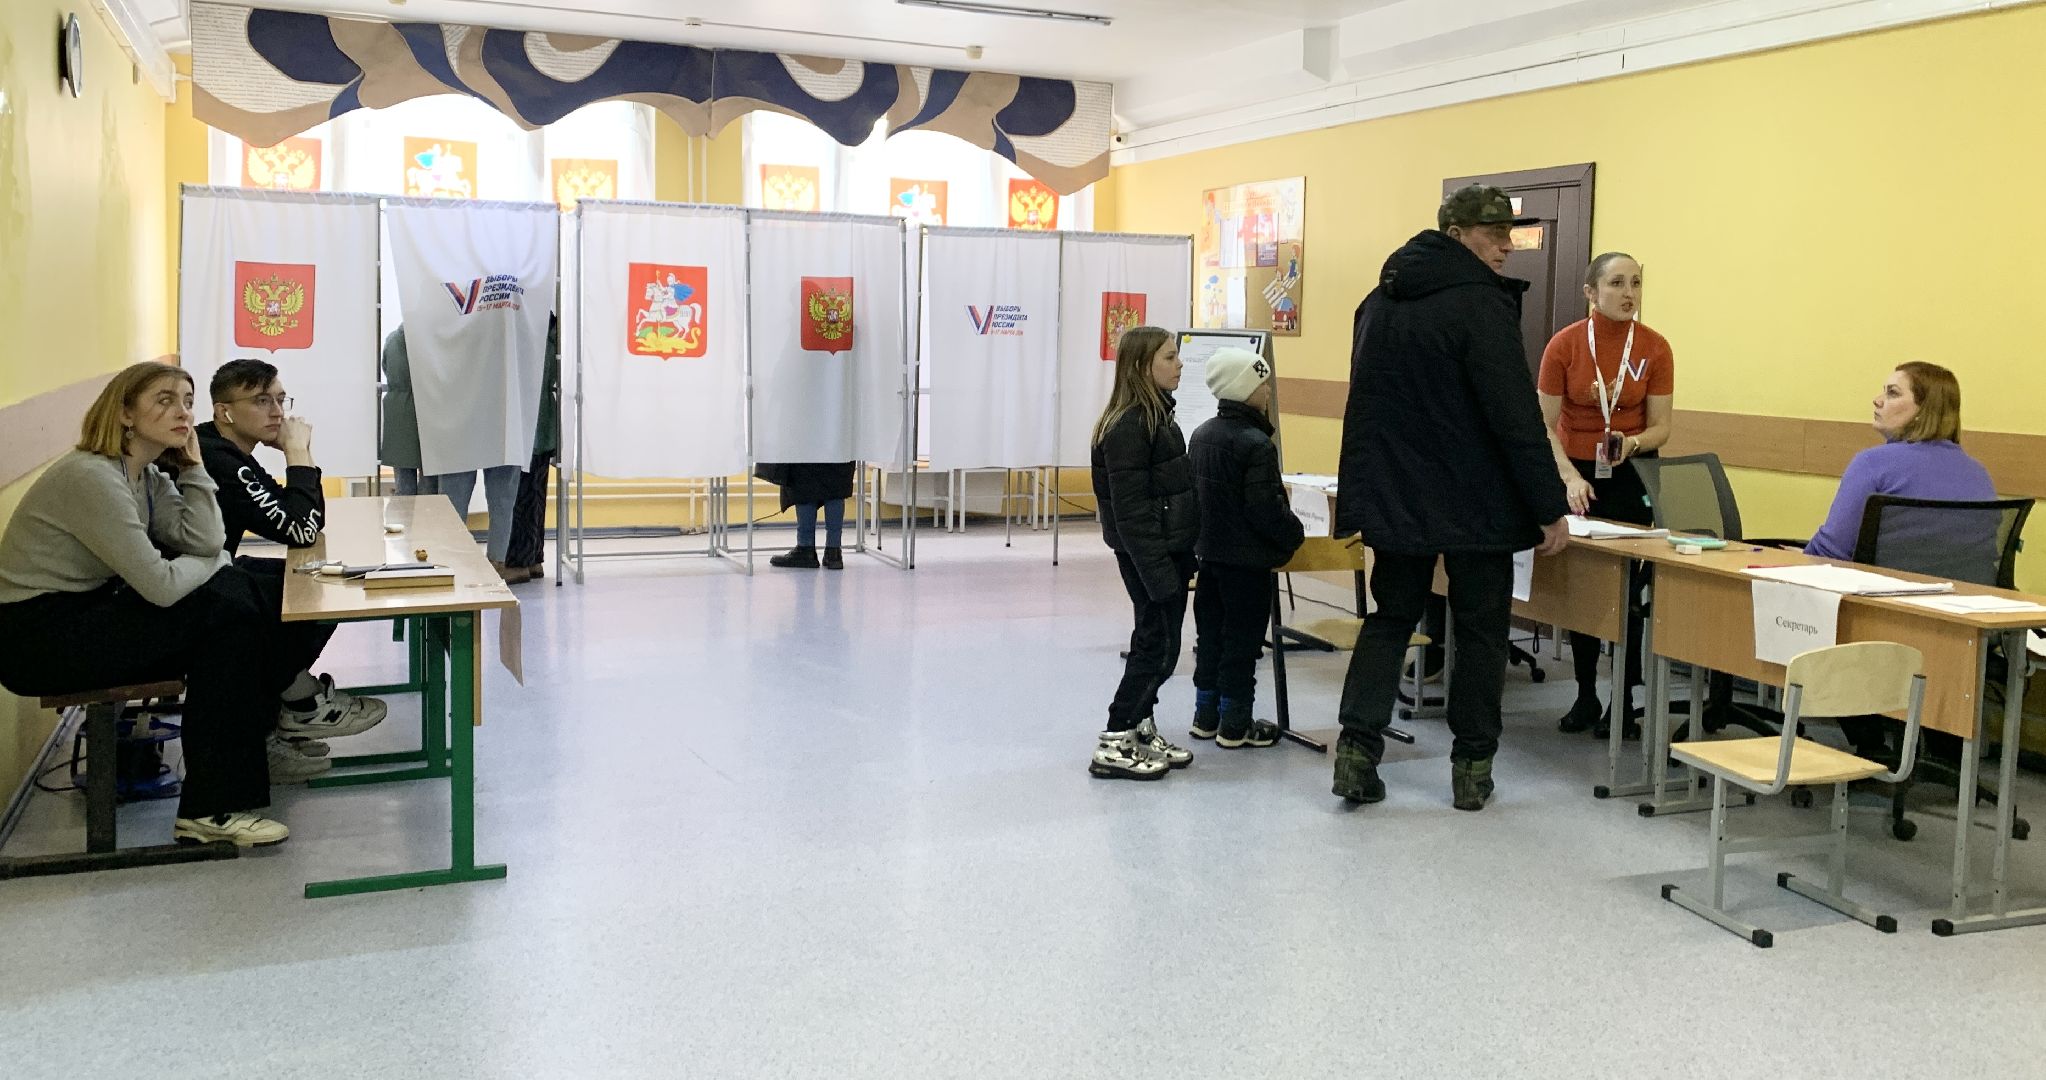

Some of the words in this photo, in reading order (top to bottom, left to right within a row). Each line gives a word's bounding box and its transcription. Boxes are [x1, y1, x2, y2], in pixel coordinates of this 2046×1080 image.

[484, 274, 518, 284] ВЫБОРЫ
[482, 282, 525, 296] ПРЕЗИДЕНТА
[479, 292, 511, 304] РОССИИ
[993, 313, 1028, 322] ПРЕЗИДНТА
[1775, 615, 1819, 637] Секретарь
